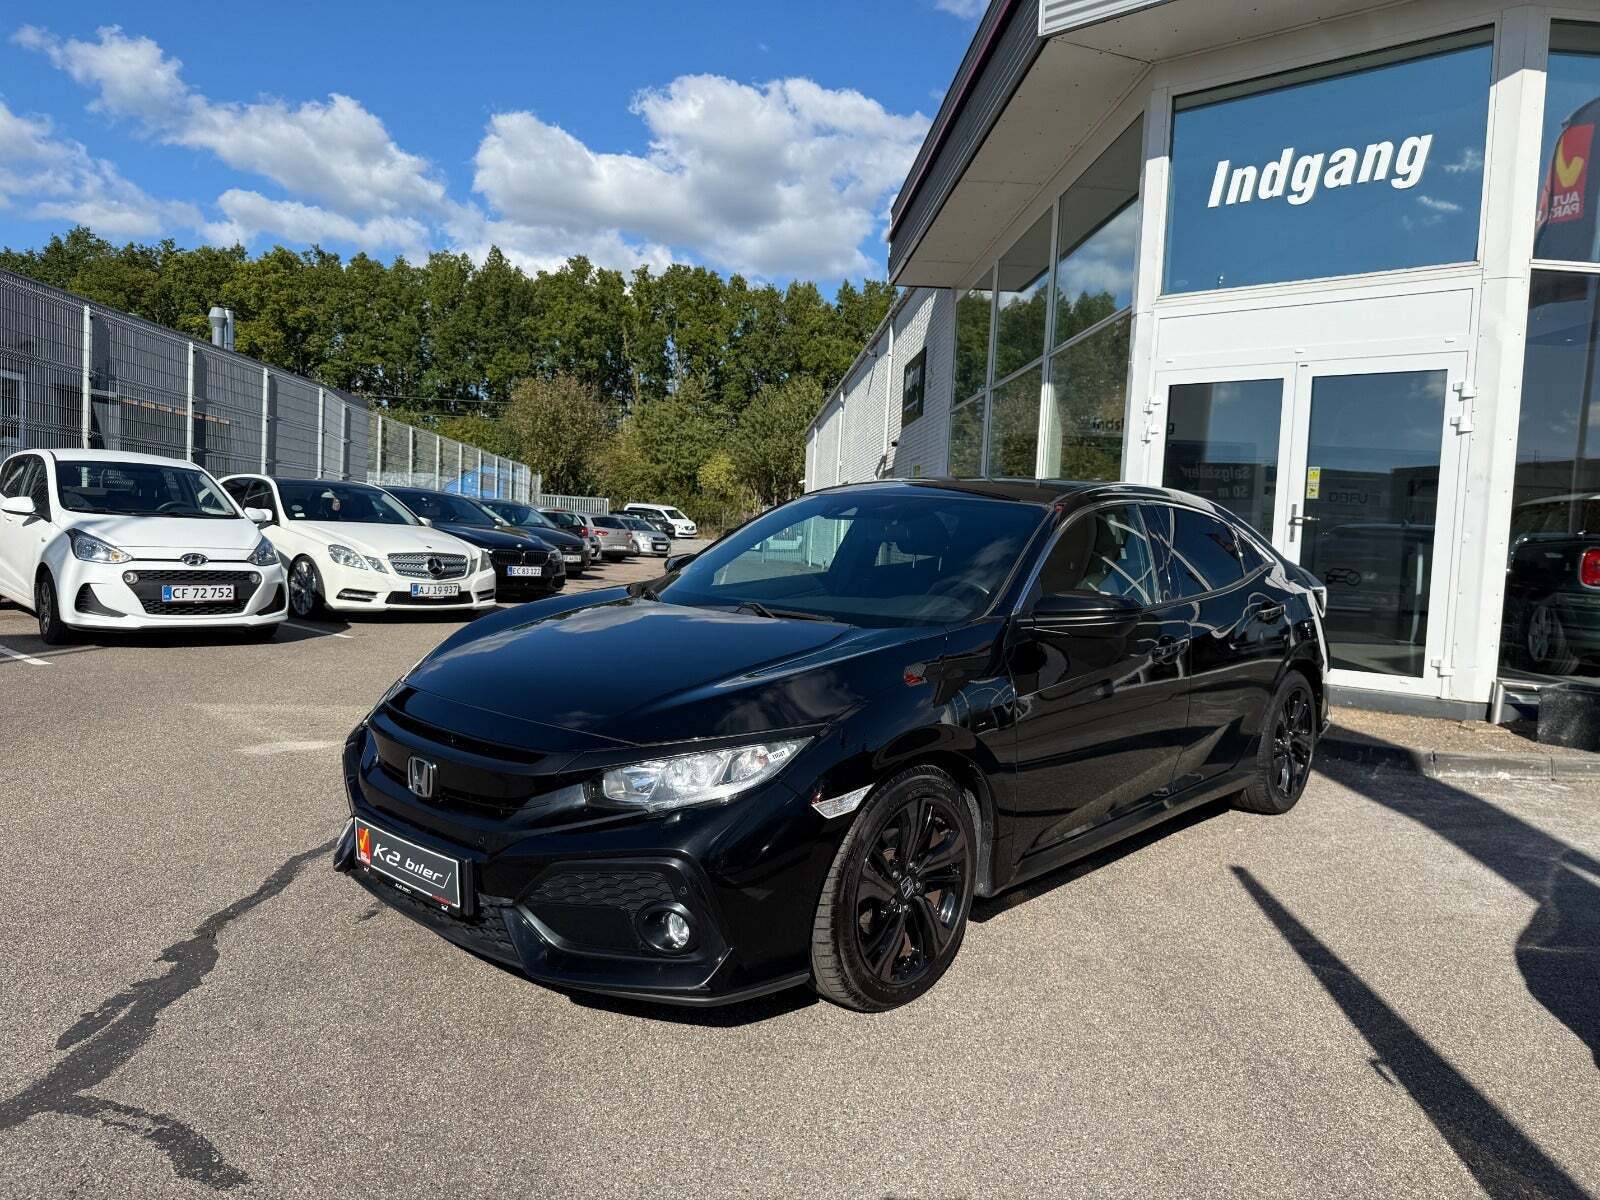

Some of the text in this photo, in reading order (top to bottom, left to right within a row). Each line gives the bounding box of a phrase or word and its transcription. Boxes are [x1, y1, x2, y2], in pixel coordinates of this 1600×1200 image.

[1207, 134, 1433, 208] Indgang
[172, 587, 232, 599] CF 72 752
[419, 585, 458, 595] AJ 19 937
[405, 857, 443, 881] biler
